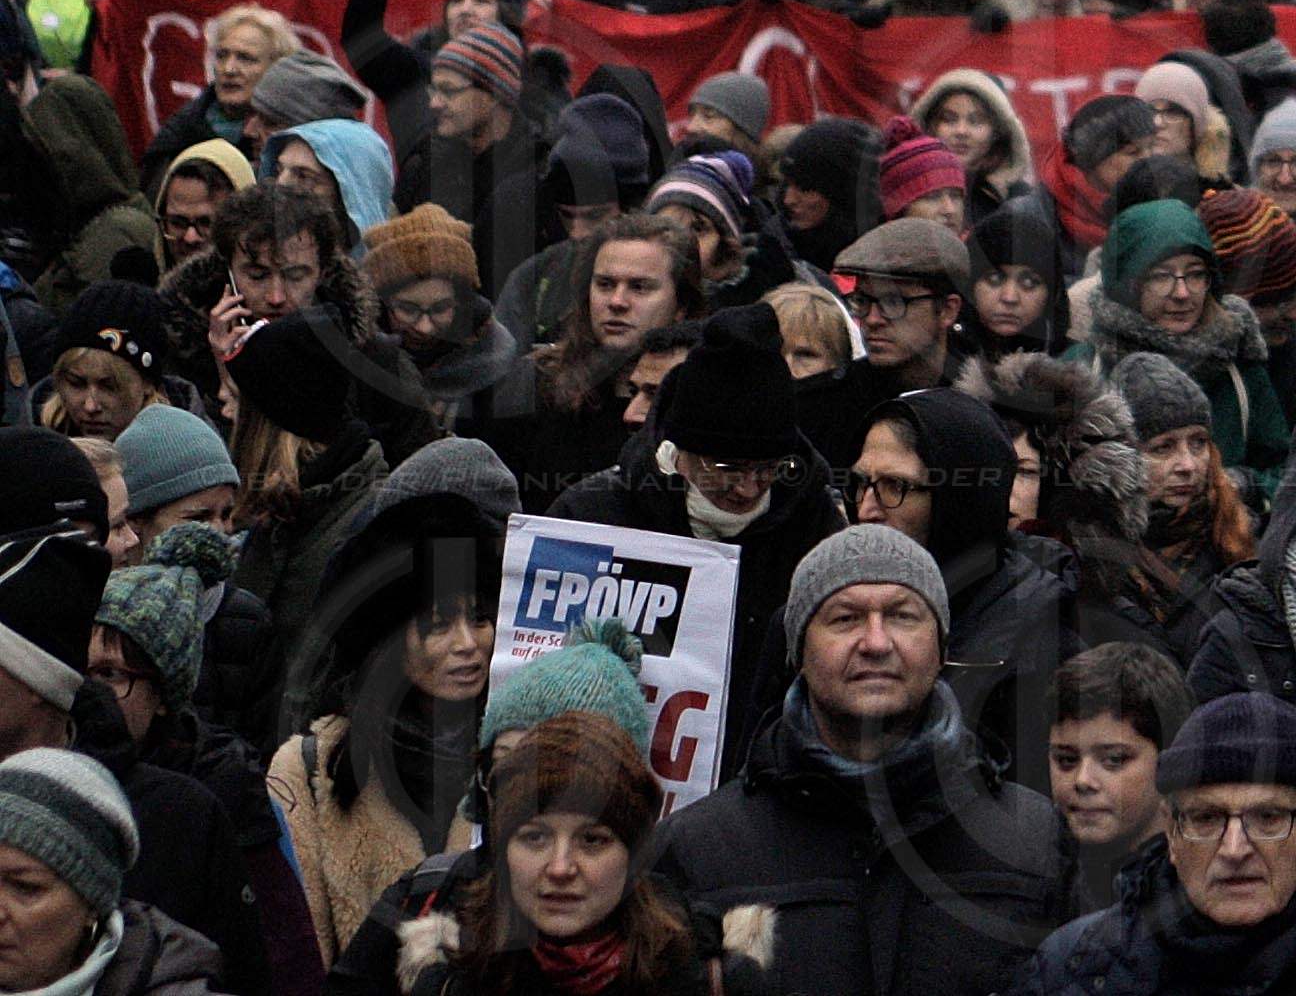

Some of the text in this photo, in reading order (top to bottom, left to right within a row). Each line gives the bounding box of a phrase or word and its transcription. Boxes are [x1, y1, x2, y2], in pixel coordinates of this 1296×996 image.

[526, 562, 679, 636] FPÖVP
[514, 630, 526, 642] In
[527, 632, 547, 645] der
